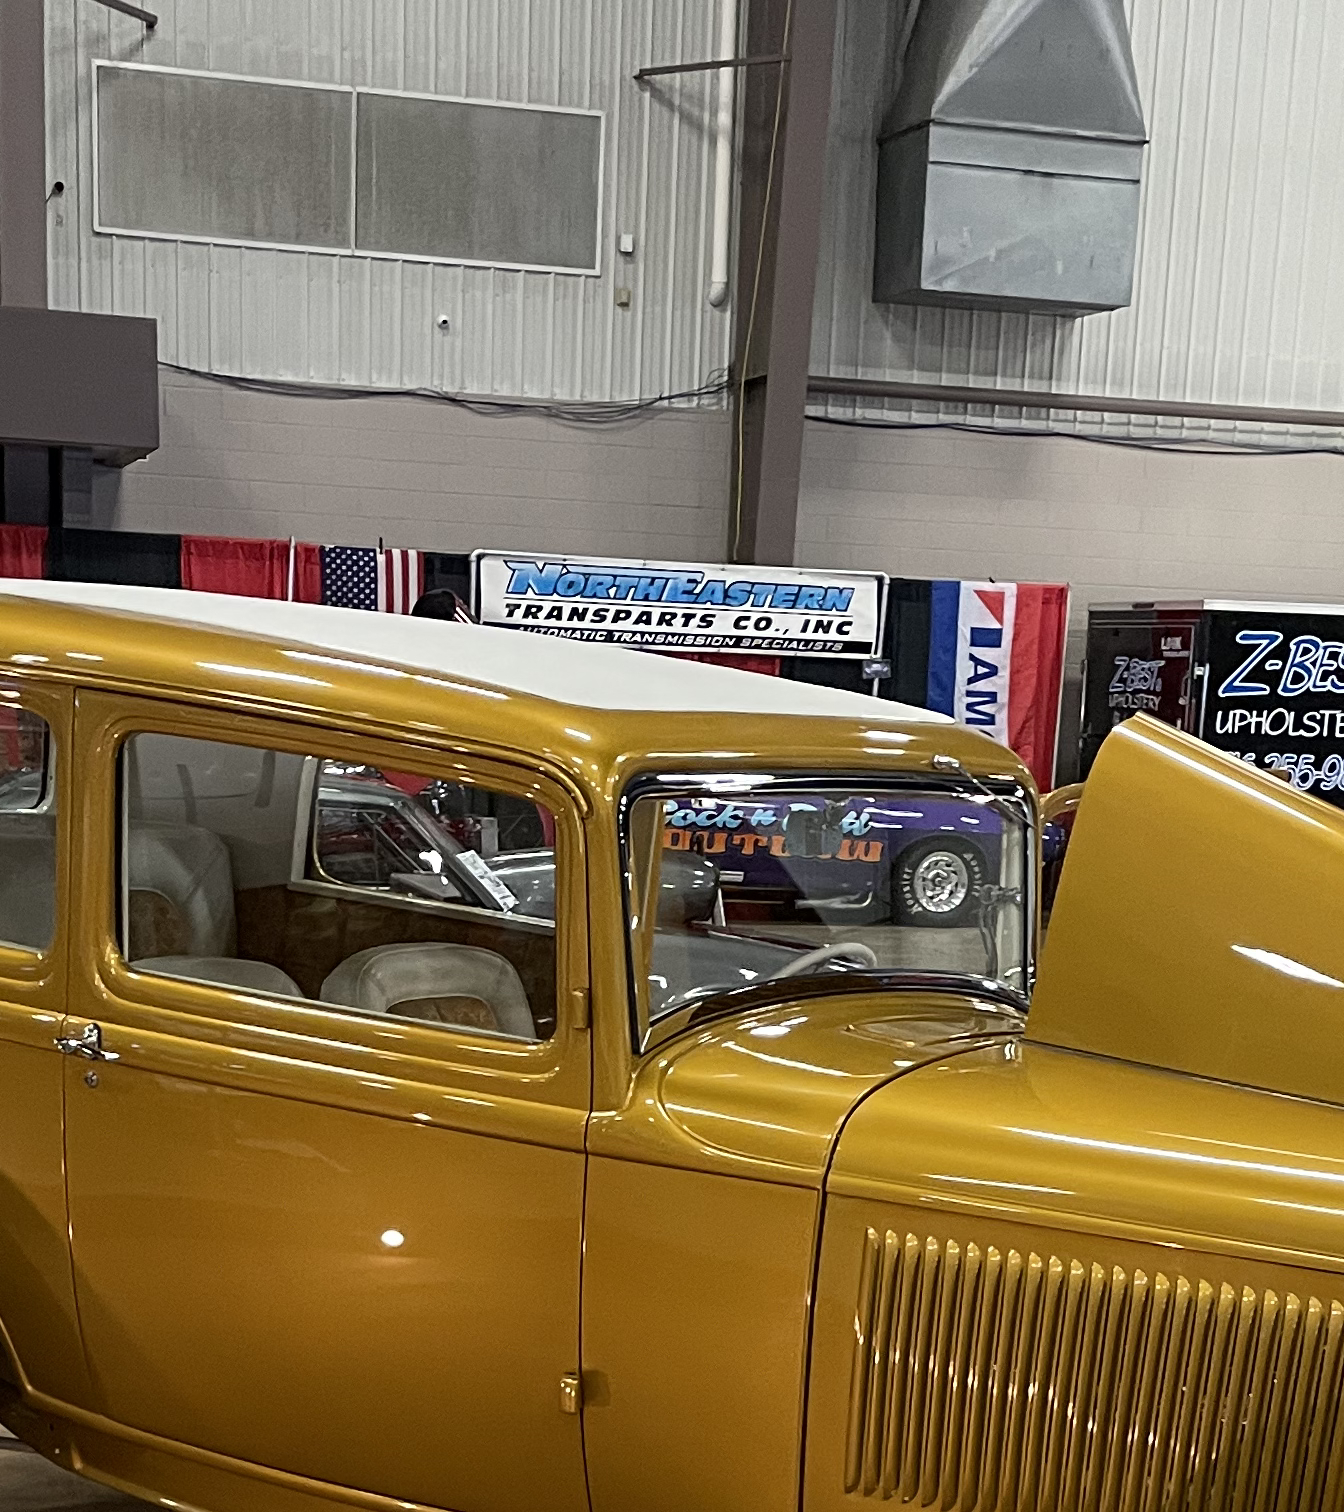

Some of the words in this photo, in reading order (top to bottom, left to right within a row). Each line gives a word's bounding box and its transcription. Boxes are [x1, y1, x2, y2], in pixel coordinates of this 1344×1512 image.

[505, 603, 717, 629] TRANSPARTS
[733, 615, 790, 636] CO.,
[800, 618, 854, 636] INC
[612, 631, 737, 646] TRANSMISSION
[740, 637, 844, 651] SPECIALISTS
[663, 828, 884, 863] OUTLW
